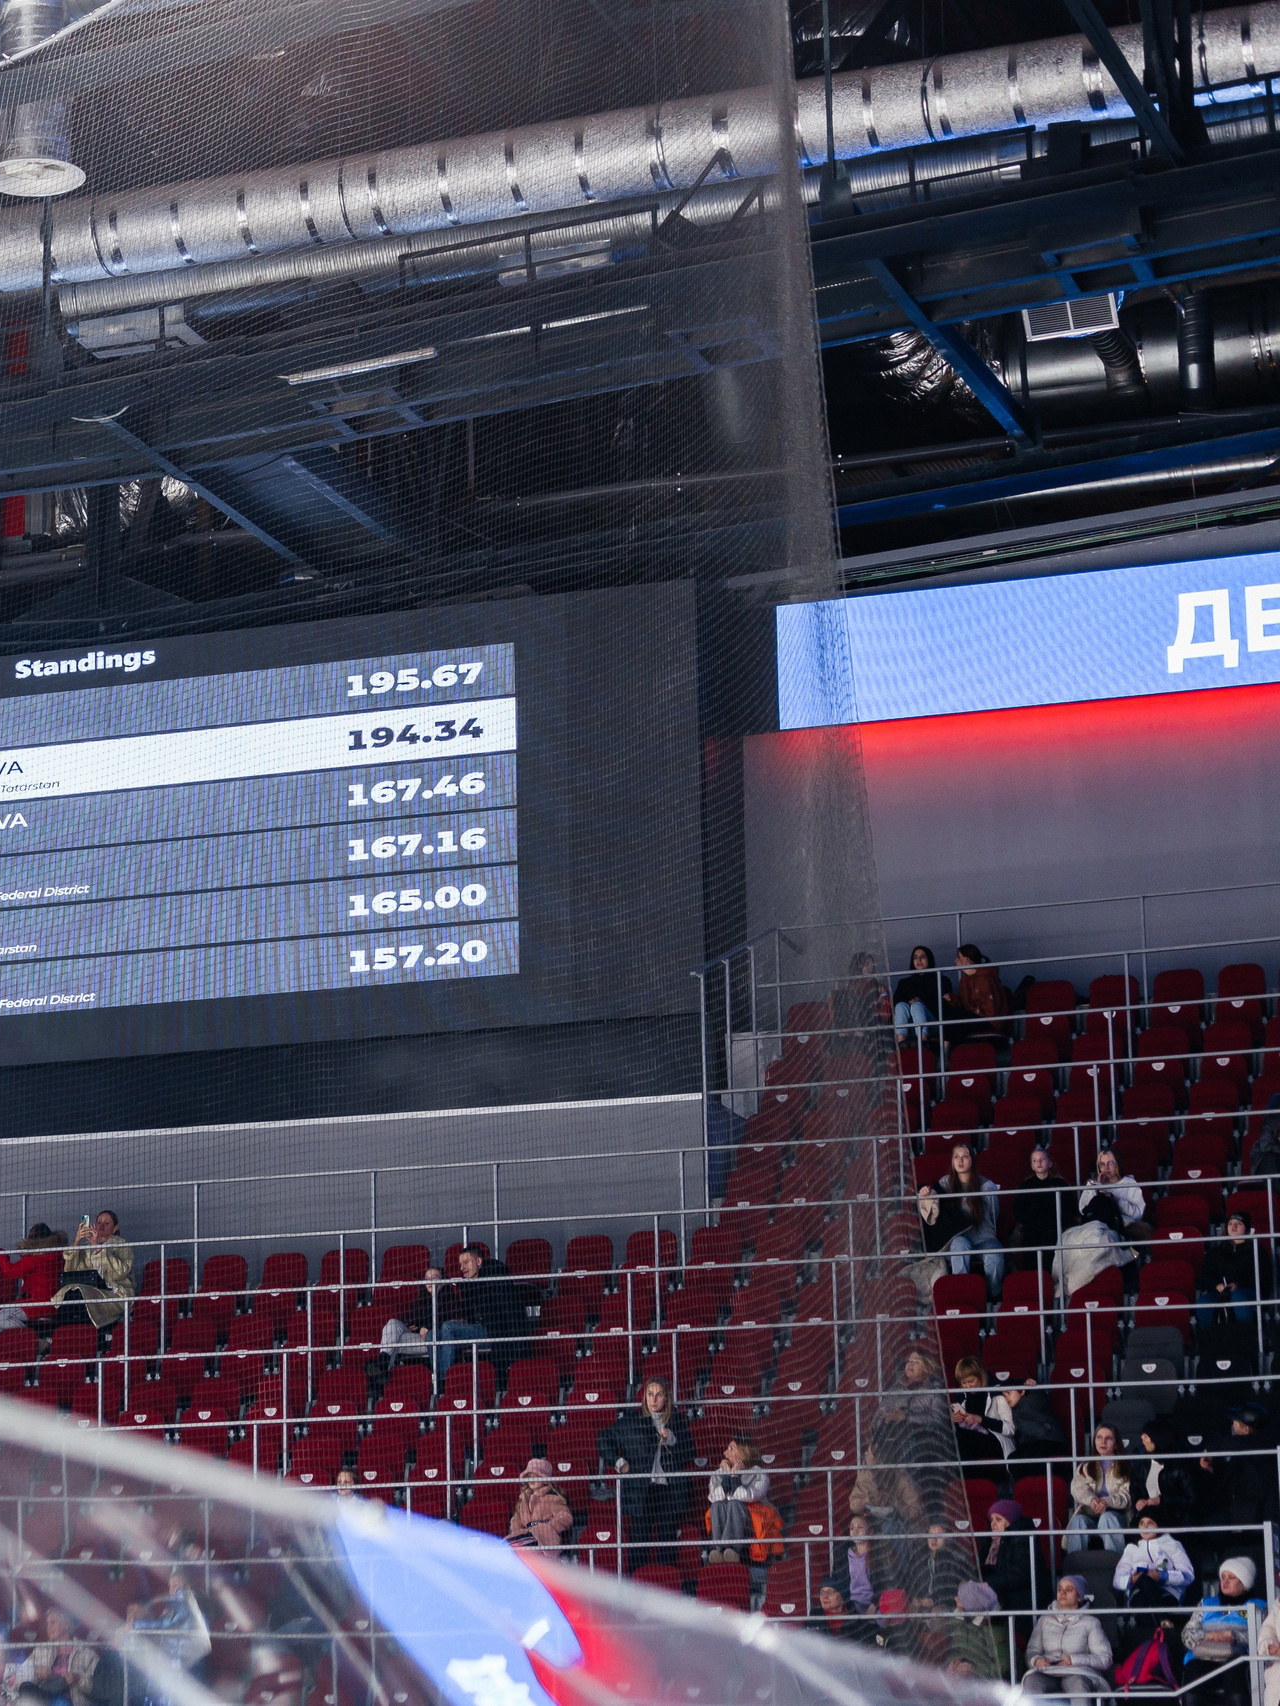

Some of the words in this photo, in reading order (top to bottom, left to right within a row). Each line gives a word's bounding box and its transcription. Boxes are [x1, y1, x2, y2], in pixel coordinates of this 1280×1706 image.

[15, 650, 156, 679] Standings
[347, 662, 484, 697] 195.67
[348, 717, 484, 751] 194.34
[0, 780, 60, 794] Tatarstan
[348, 771, 486, 807] 167.46
[348, 827, 487, 861] 167.16
[44, 884, 90, 897] District
[349, 883, 487, 917] 165.00
[349, 939, 488, 973] 157.20
[0, 995, 48, 1010] Federal
[49, 992, 96, 1005] District
